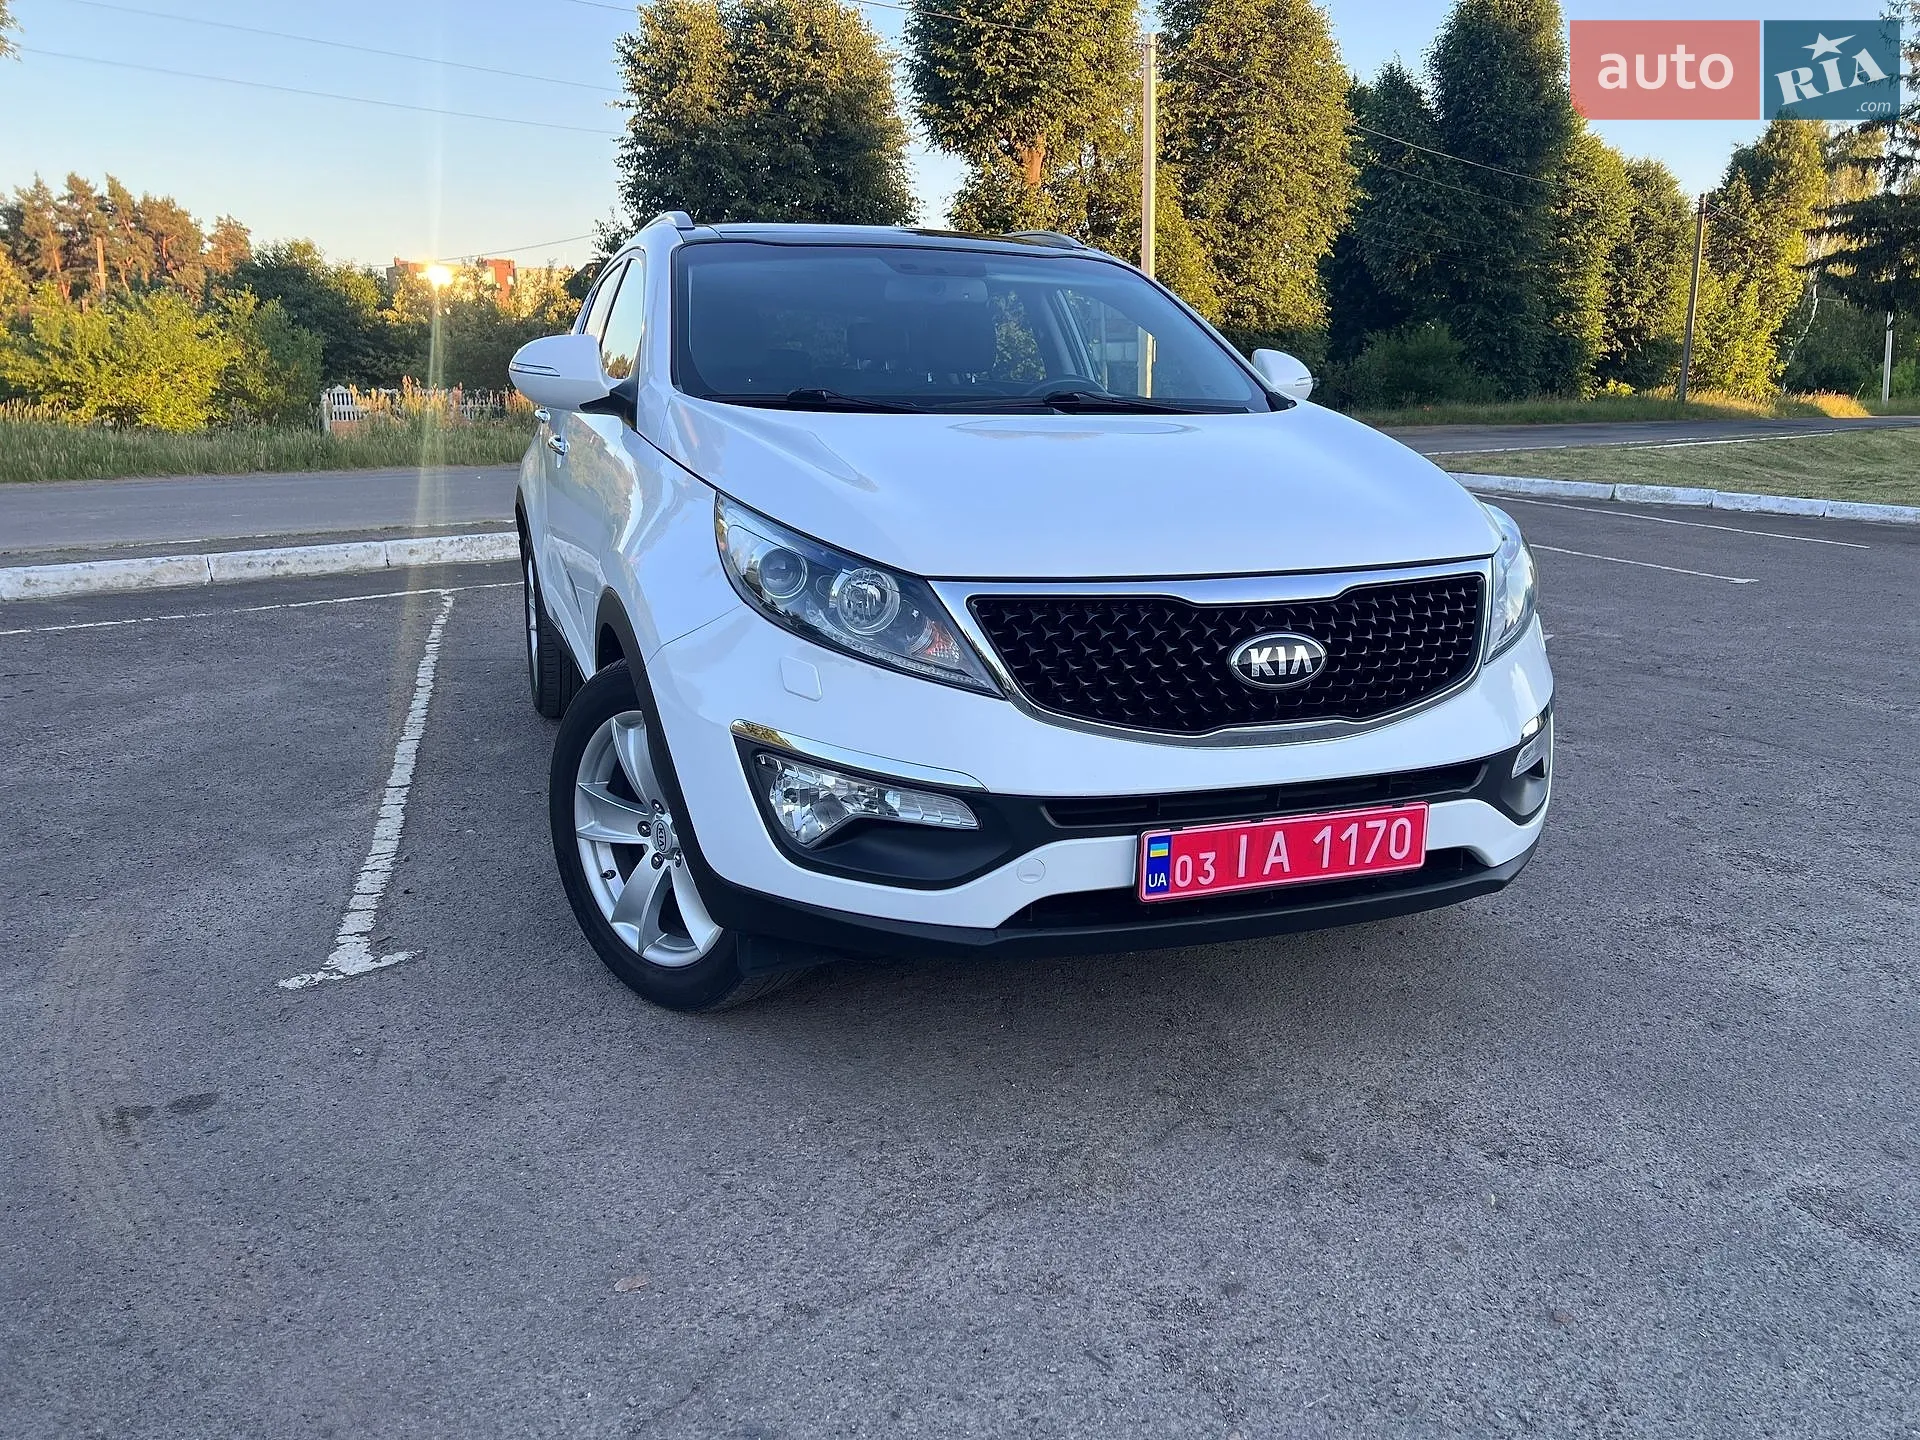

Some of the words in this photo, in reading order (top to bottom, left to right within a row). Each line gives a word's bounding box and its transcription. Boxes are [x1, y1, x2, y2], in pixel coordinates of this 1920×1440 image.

[1248, 645, 1313, 677] KIA
[1174, 851, 1216, 888] 03
[1237, 830, 1291, 878] IA
[1312, 817, 1412, 869] 1170
[1148, 872, 1167, 888] UA
